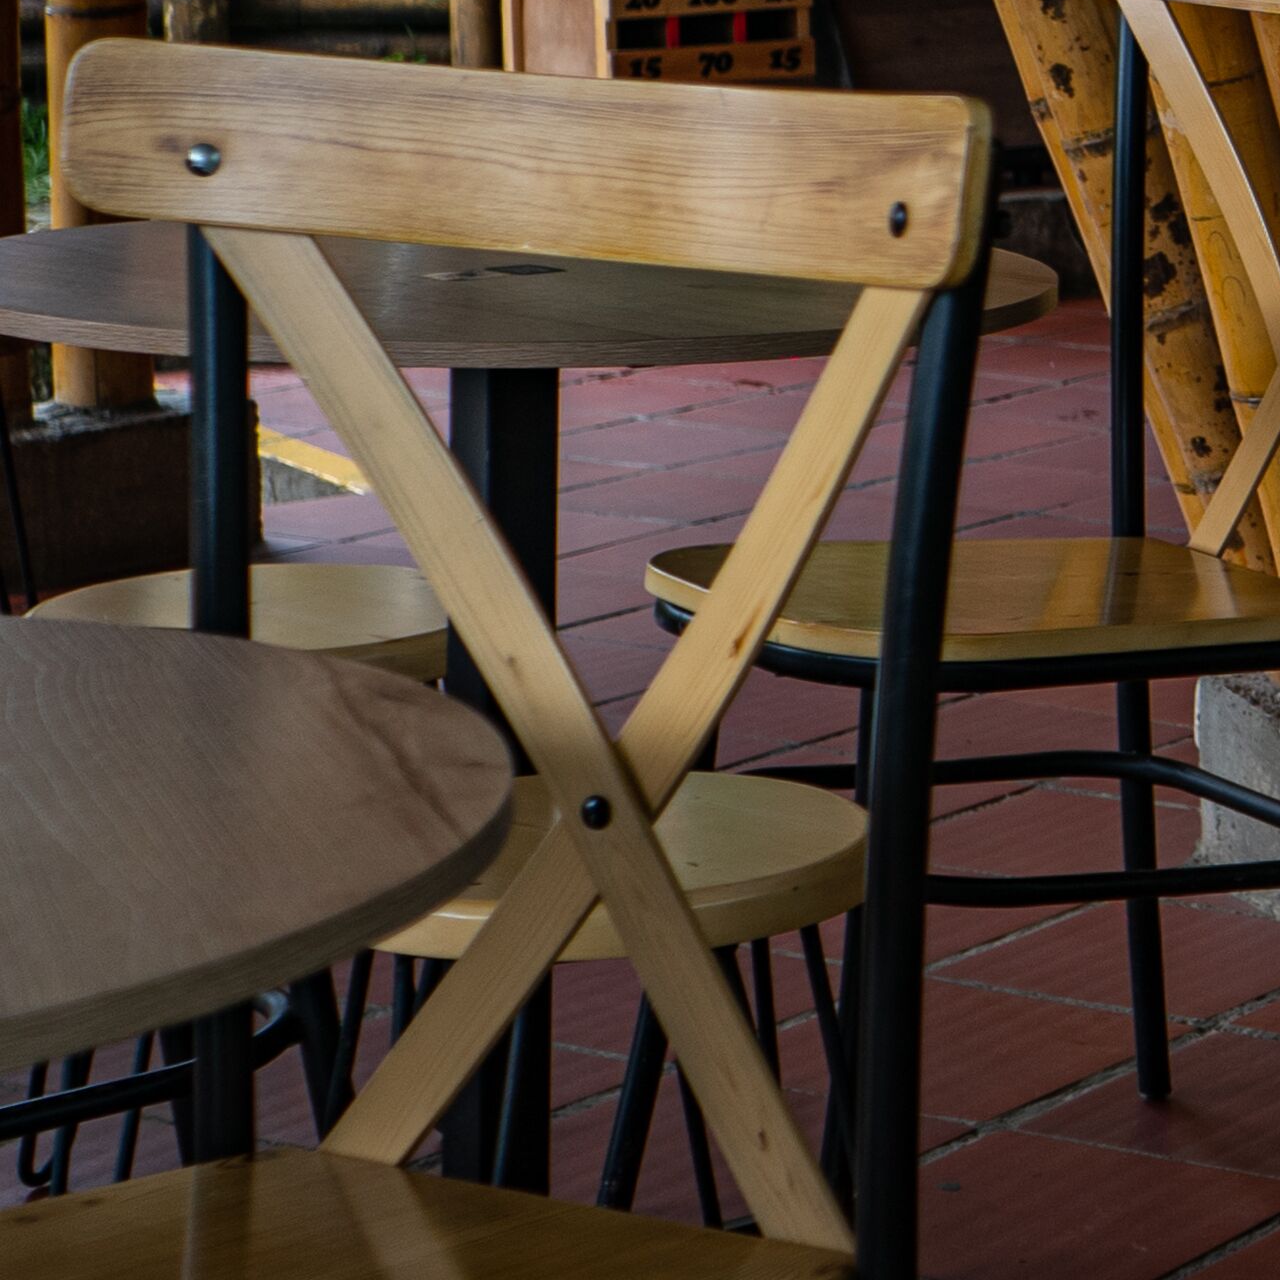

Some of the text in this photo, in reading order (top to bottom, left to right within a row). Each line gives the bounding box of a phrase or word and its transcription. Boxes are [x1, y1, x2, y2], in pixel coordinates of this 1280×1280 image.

[629, 47, 802, 78] 15 70 15
